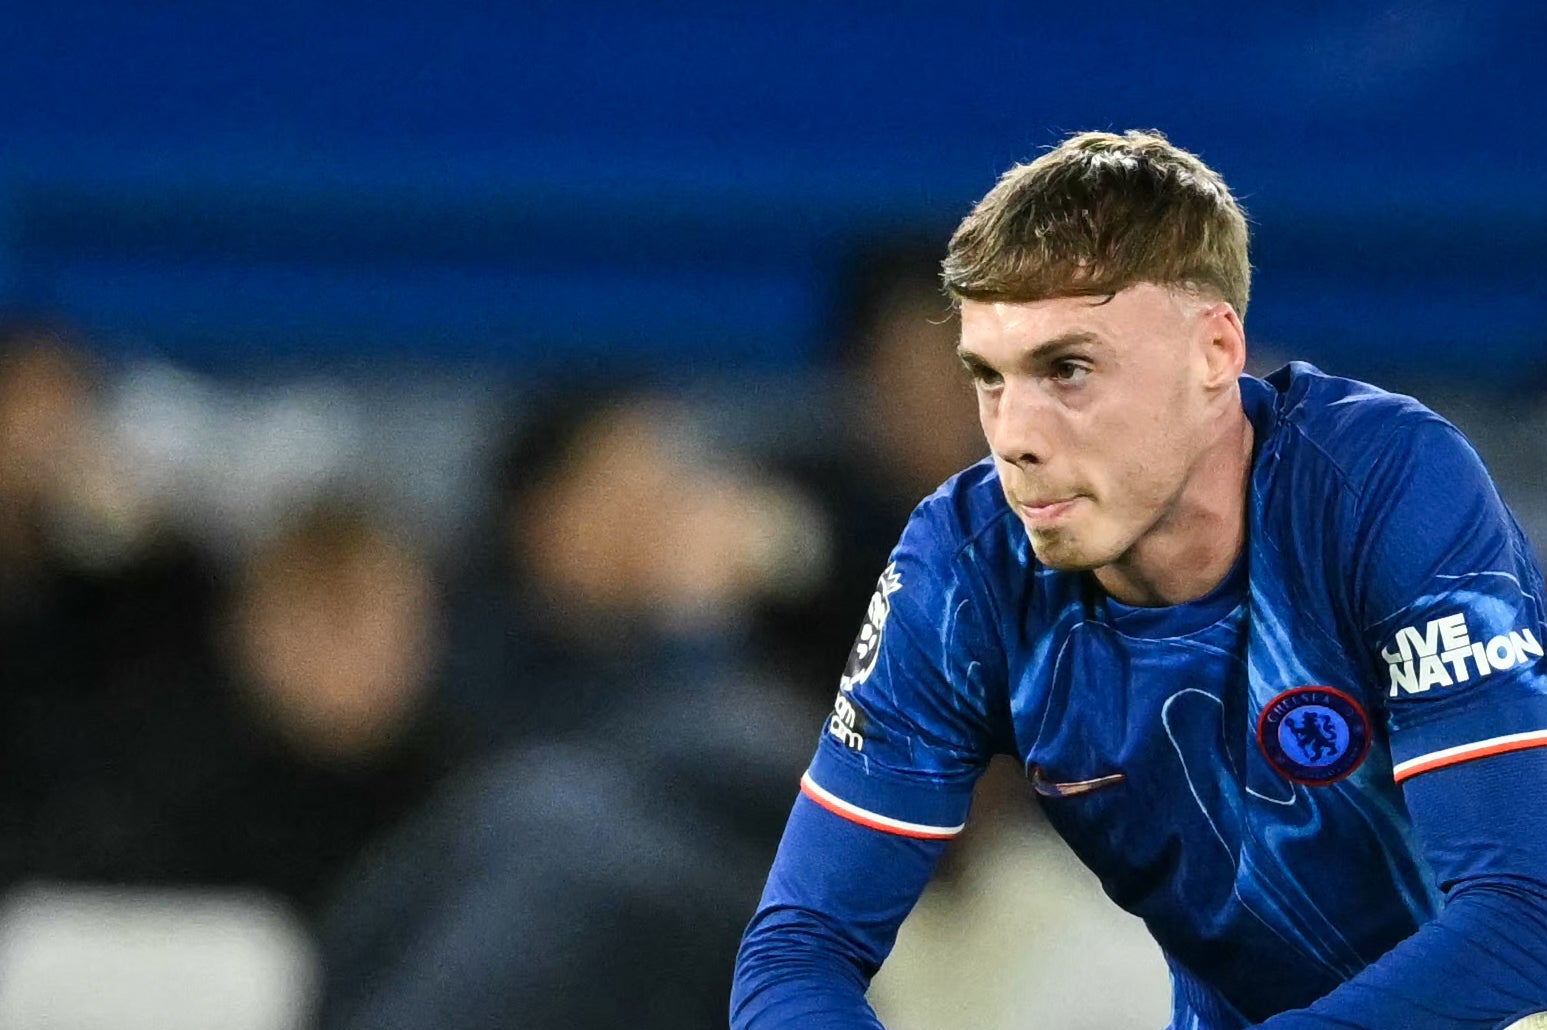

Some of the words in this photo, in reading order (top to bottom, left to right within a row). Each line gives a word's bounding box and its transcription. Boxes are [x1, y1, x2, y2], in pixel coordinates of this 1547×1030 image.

[1381, 612, 1470, 664] LIVE
[1389, 628, 1545, 697] NATION
[1267, 692, 1330, 723] CHELSEA
